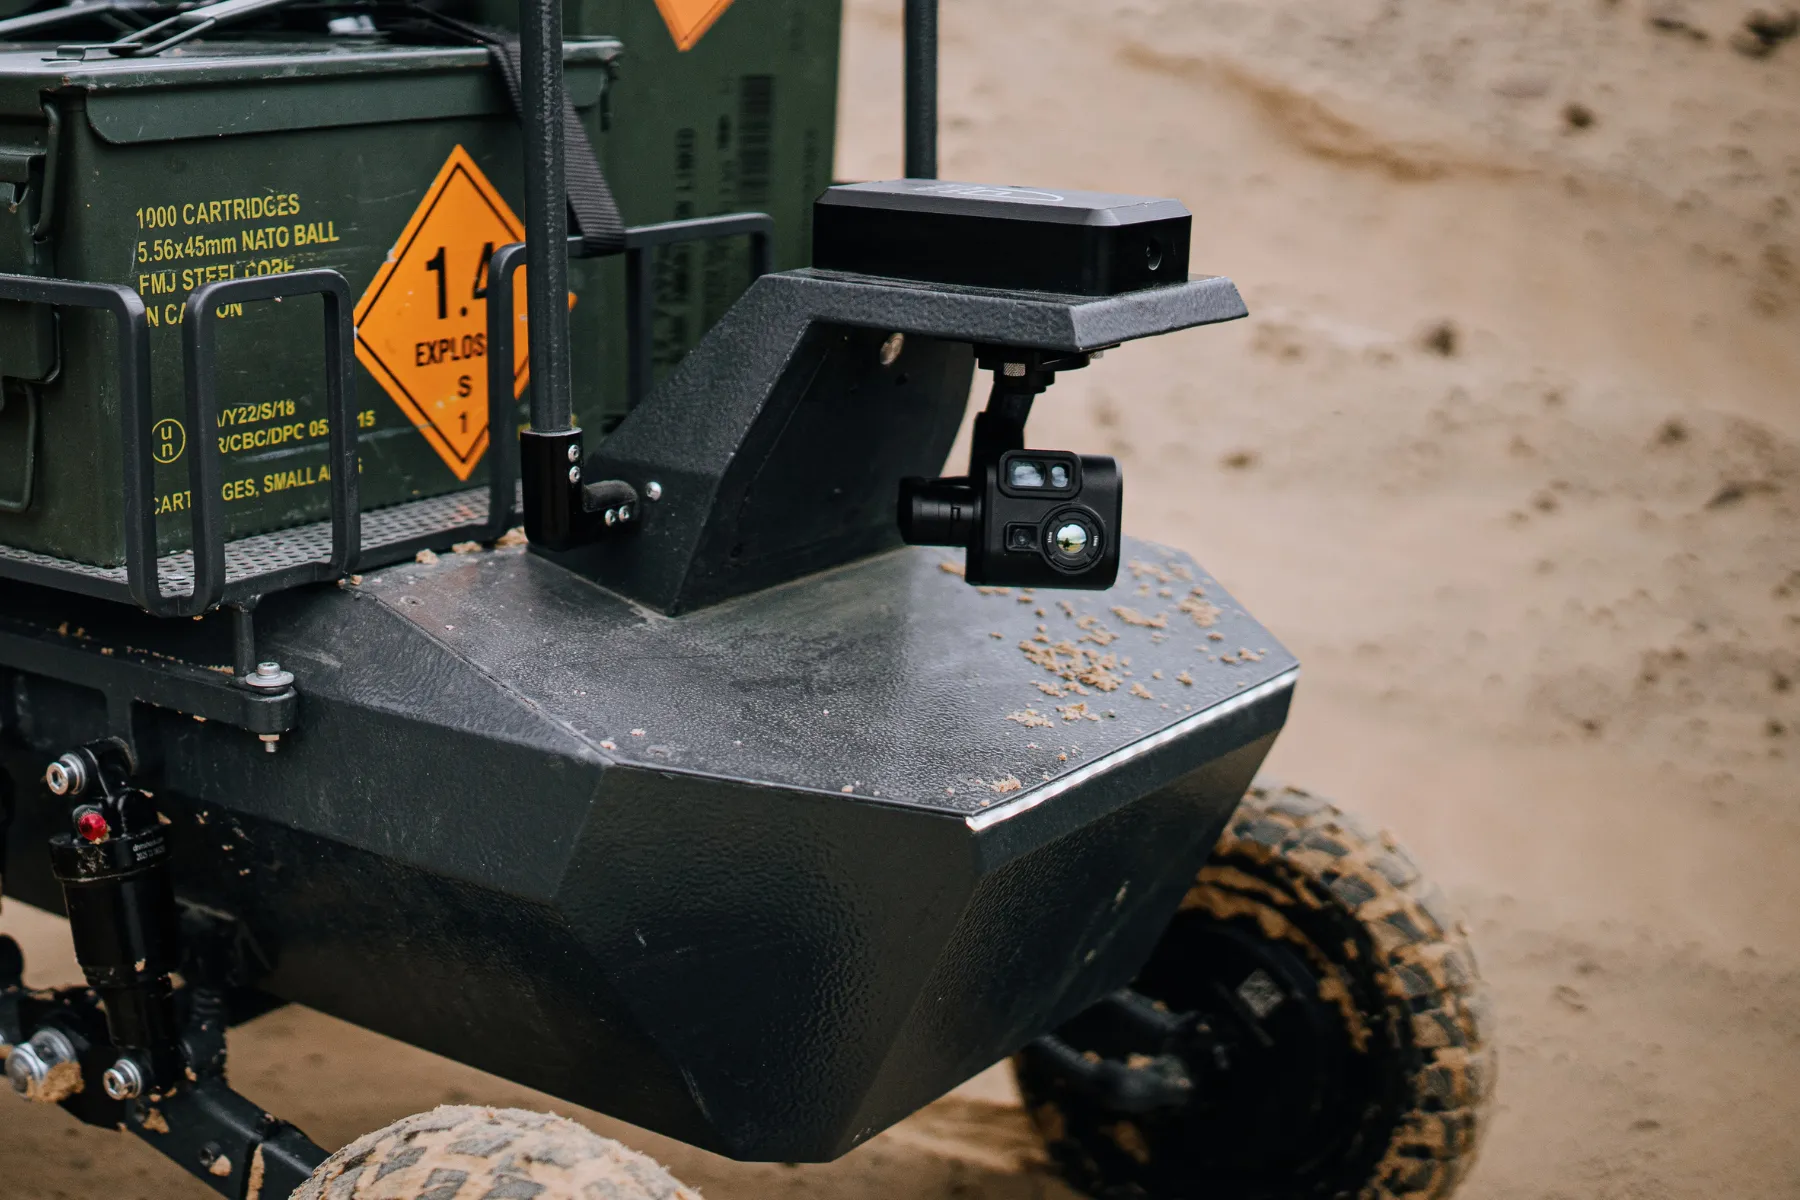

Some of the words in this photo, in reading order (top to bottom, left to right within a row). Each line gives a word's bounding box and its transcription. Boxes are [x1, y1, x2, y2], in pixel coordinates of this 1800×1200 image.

[136, 206, 177, 229] 1000
[183, 193, 300, 224] CARTRIDGES
[138, 235, 237, 263] 5.56x45mm
[242, 226, 289, 250] NATO
[294, 221, 339, 245] BALL
[139, 273, 176, 296] FMJ
[457, 374, 472, 398] S
[458, 411, 468, 434] 1
[263, 467, 315, 493] SMALL
